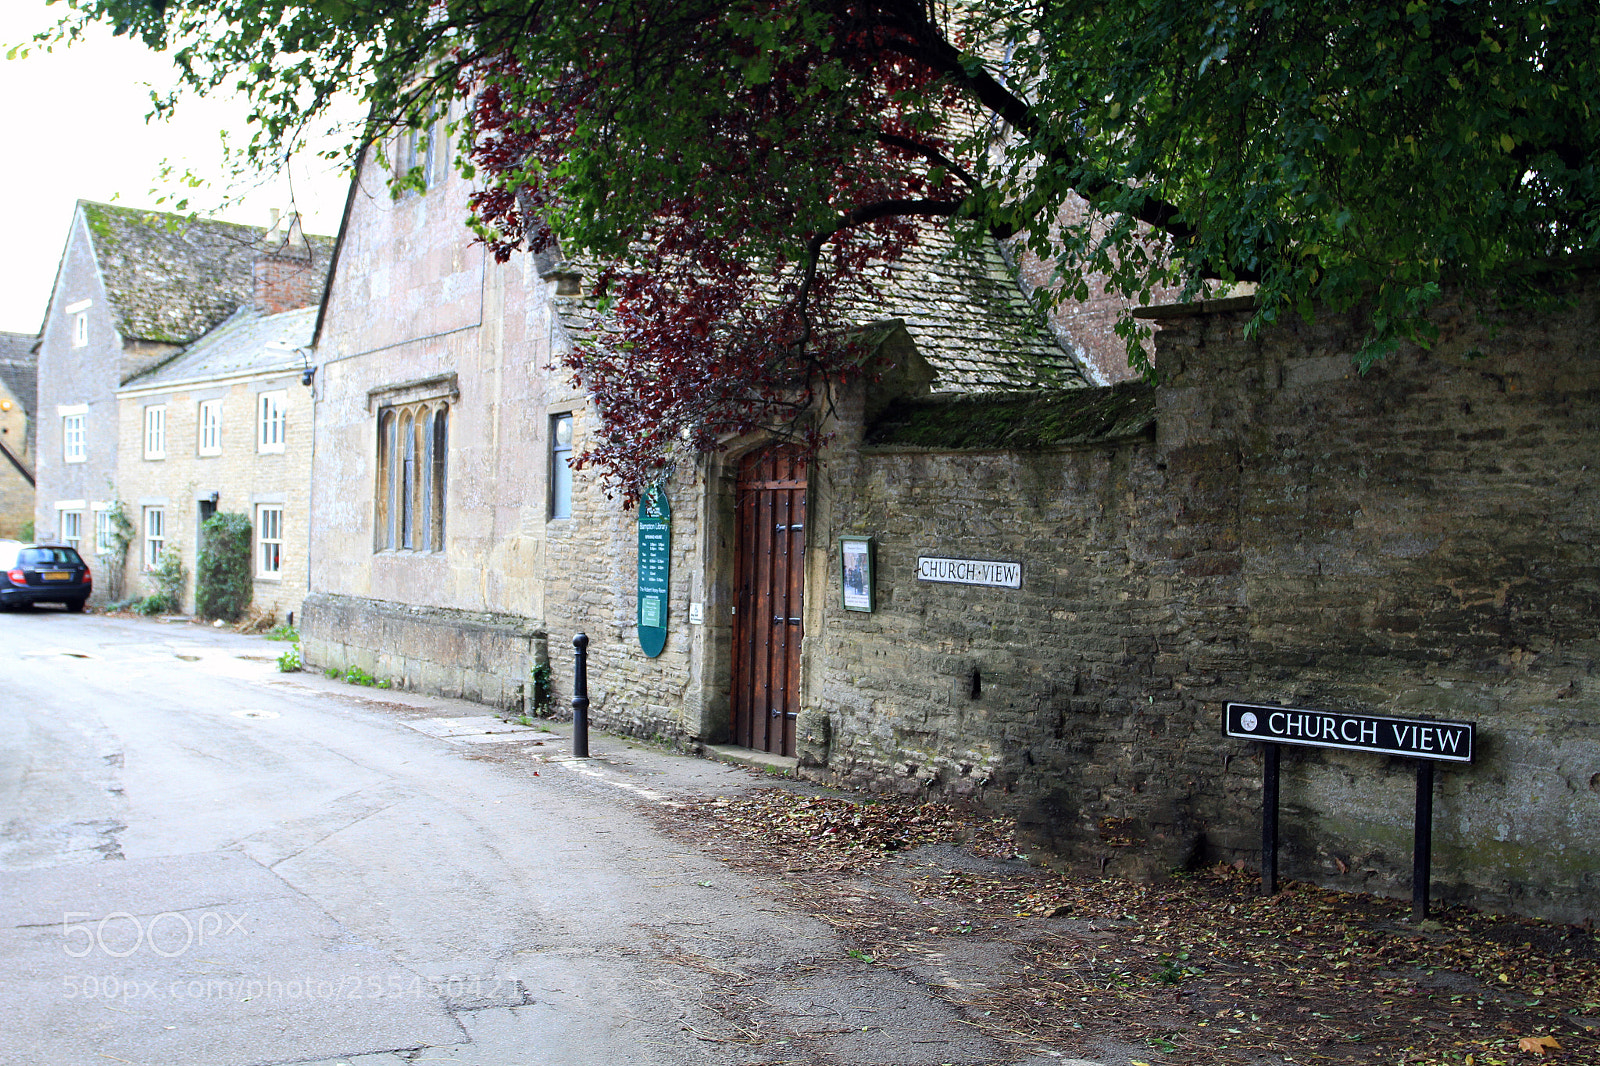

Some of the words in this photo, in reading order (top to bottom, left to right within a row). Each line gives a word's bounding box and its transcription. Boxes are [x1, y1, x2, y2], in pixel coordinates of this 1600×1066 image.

[921, 560, 976, 580] CHURCH
[982, 564, 1016, 583] VIEW
[1268, 712, 1378, 744] CHURCH
[1392, 724, 1463, 753] VIEW
